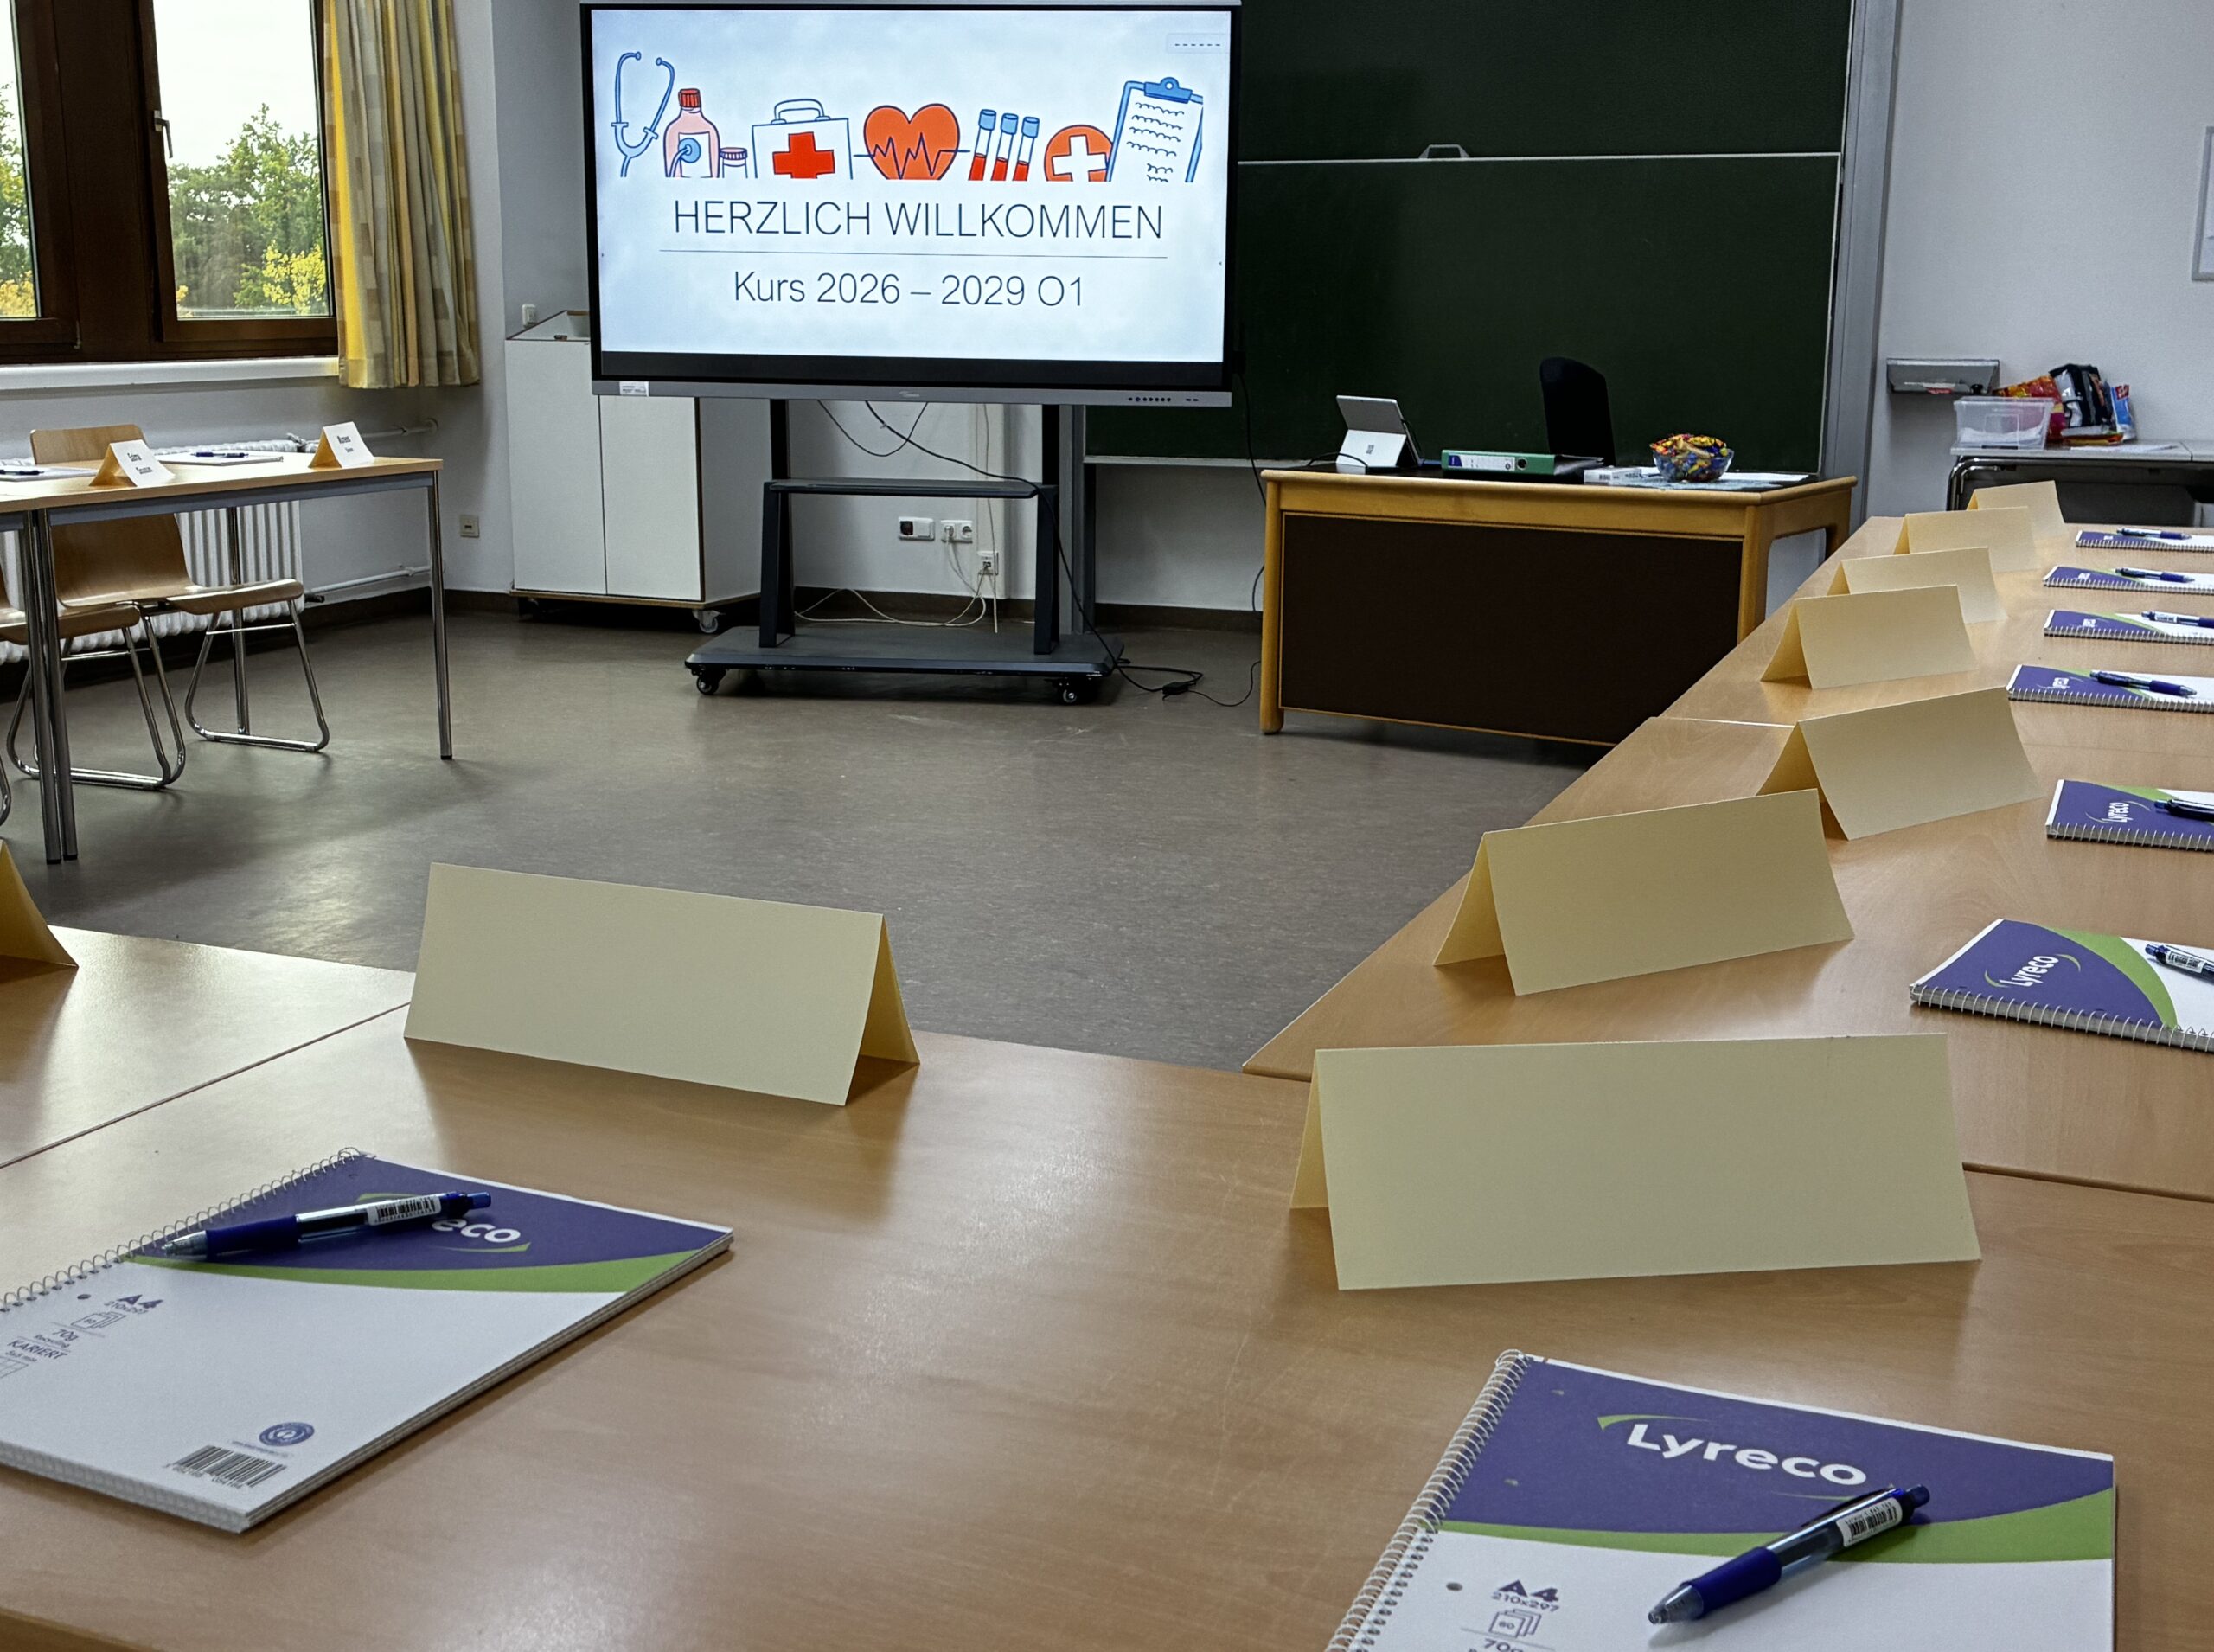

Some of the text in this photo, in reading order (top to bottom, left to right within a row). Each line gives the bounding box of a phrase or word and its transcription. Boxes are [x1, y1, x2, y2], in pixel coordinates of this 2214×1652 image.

[675, 200, 1161, 239] HERZLICH WILLKOMMEN
[735, 271, 805, 303] Kurs
[817, 272, 900, 304] 2026
[941, 274, 1025, 306] 2029
[2101, 802, 2134, 823] Lyreco
[1999, 956, 2059, 987] Lyreco
[432, 1218, 521, 1243] eco
[116, 1294, 163, 1309] A4
[52, 1329, 79, 1341] 70g
[7, 1340, 68, 1360] KARIERT
[1627, 1424, 1866, 1486] Lyreco
[1491, 1591, 1560, 1612] 210x297
[1498, 1579, 1559, 1602] A4
